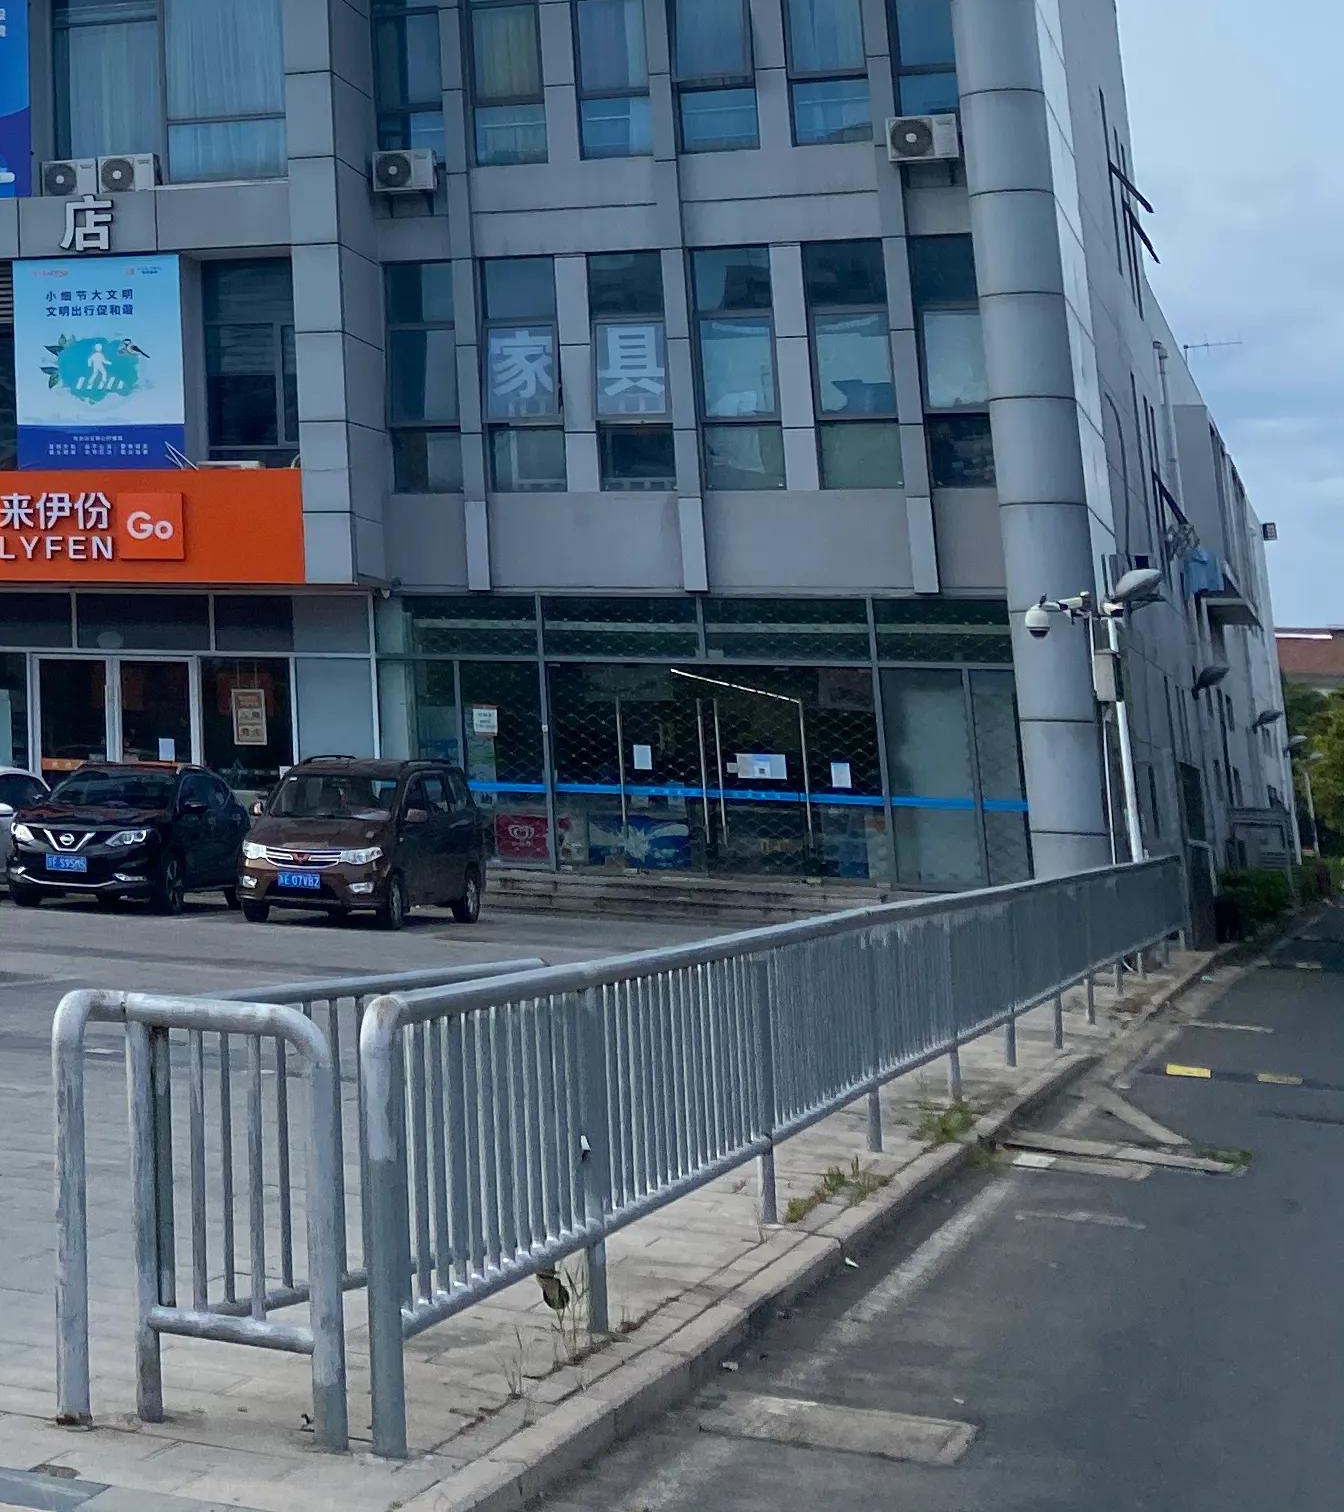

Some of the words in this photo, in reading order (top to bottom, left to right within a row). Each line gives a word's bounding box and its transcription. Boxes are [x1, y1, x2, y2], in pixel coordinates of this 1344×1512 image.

[46, 289, 134, 303] 小细节大文明
[46, 304, 134, 318] 文明出行促和谐
[490, 327, 665, 399] 家具
[126, 510, 174, 541] Go
[0, 535, 114, 560] LYFEN
